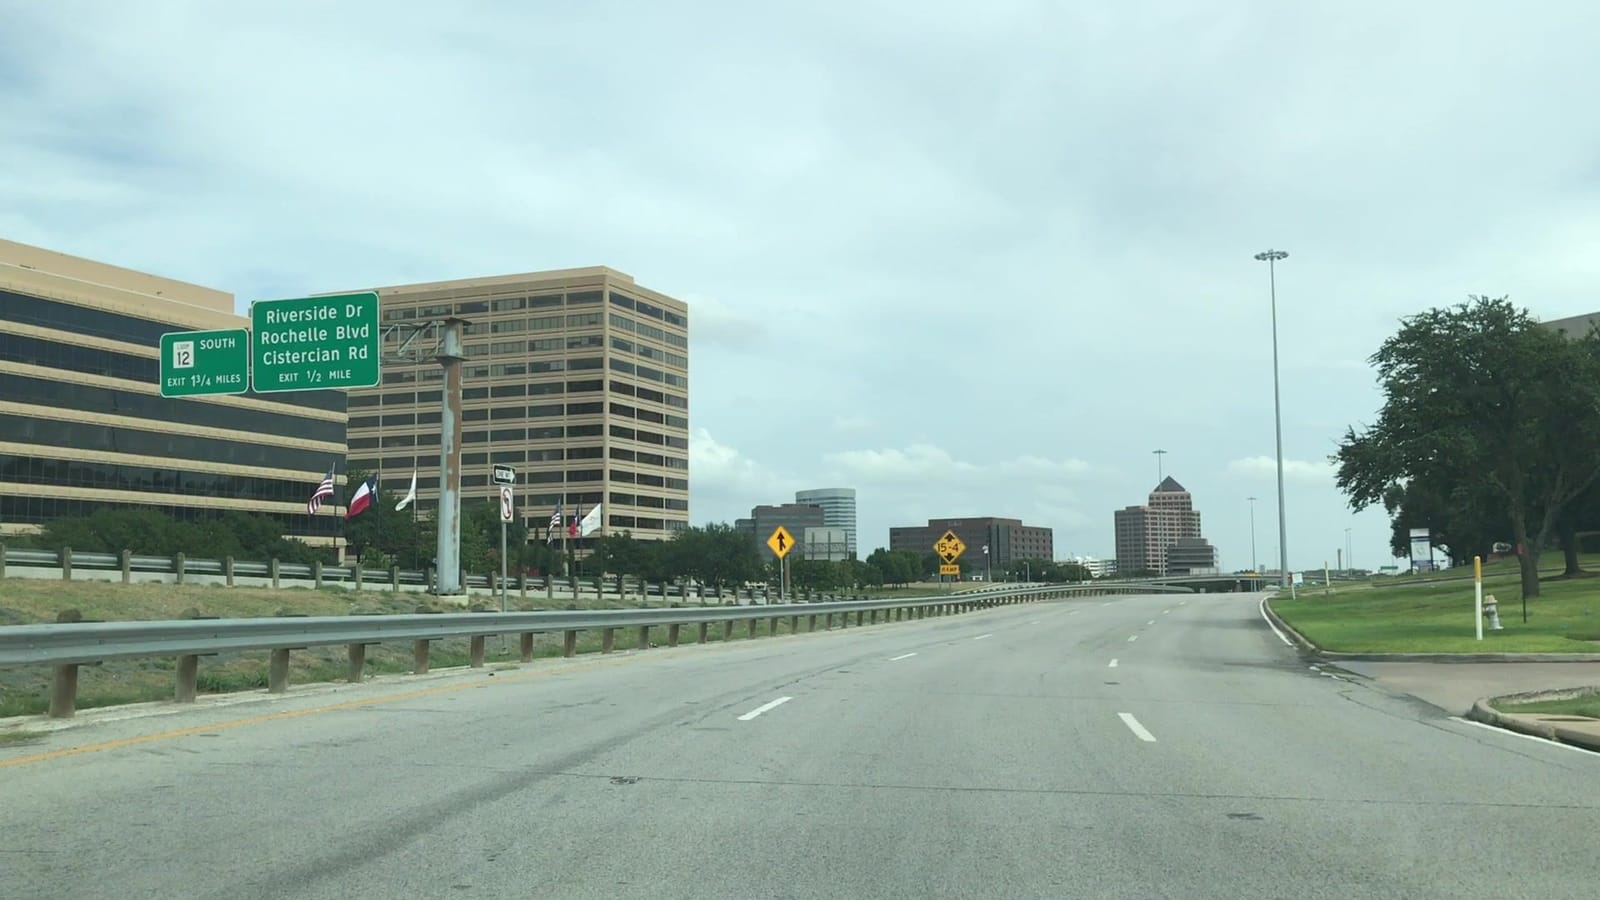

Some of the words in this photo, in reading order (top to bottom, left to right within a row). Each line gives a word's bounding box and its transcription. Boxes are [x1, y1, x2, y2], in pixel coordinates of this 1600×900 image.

[266, 305, 337, 324] Riverside
[345, 304, 363, 318] Dr
[261, 326, 328, 345] Rochelle
[336, 323, 369, 340] Blvd
[200, 338, 236, 350] SOUTH
[176, 352, 190, 366] 12
[263, 347, 340, 365] Cistercian
[348, 345, 368, 360] Rd
[167, 376, 186, 387] EXIT
[216, 373, 241, 384] MILES
[279, 370, 298, 382] EXIT
[329, 369, 351, 379] MILE
